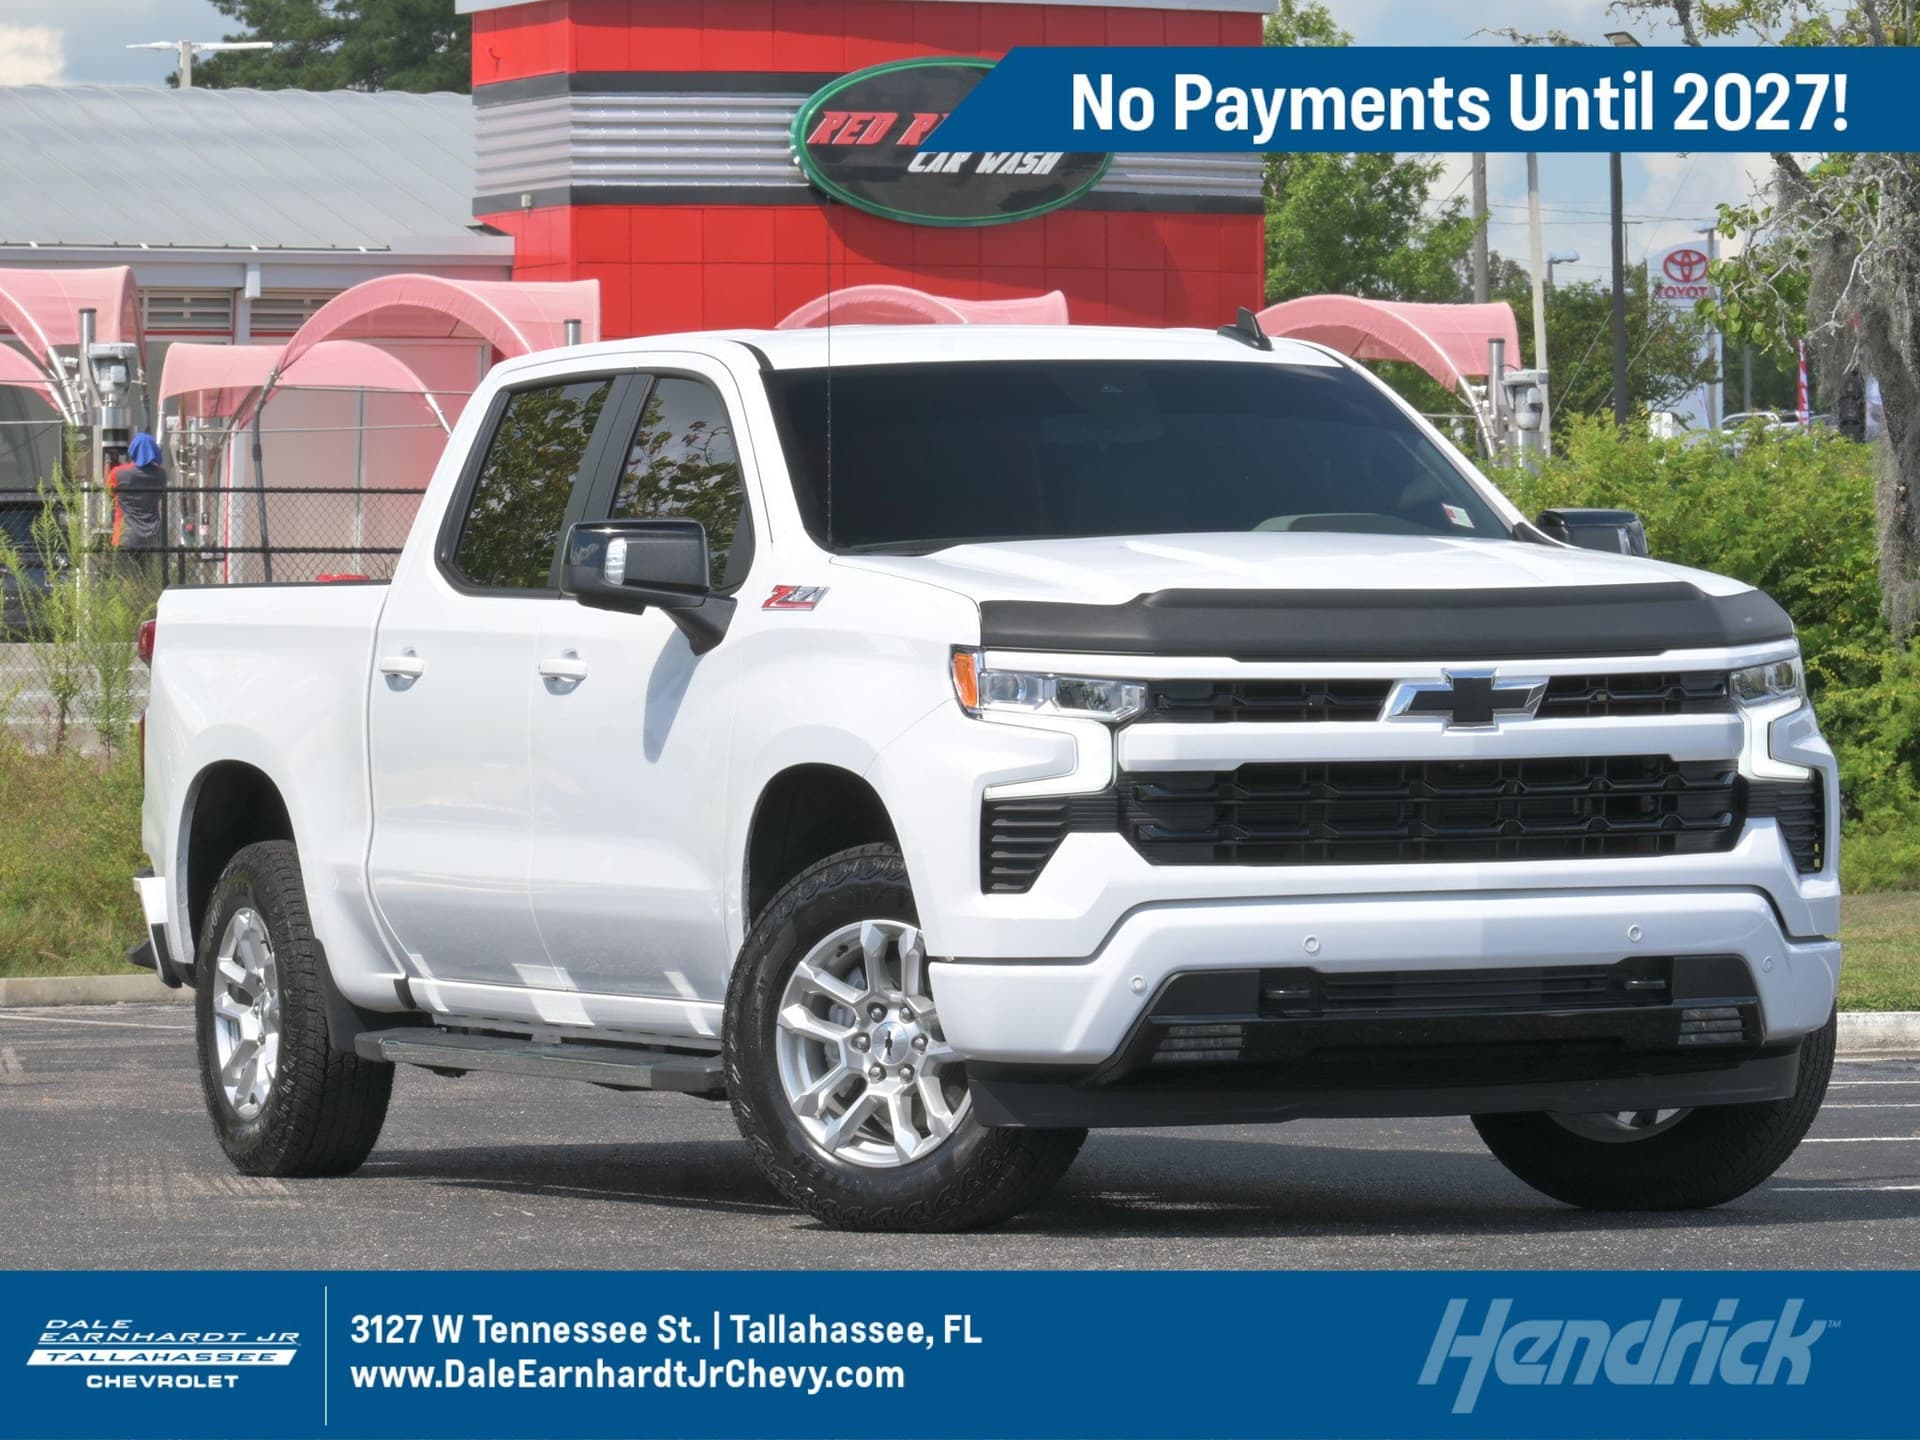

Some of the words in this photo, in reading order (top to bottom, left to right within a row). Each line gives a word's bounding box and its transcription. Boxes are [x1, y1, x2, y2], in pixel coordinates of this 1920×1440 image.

[806, 110, 899, 146] RED
[907, 151, 974, 174] CAR
[974, 151, 1065, 176] WASH
[1656, 285, 1718, 299] TOYOT
